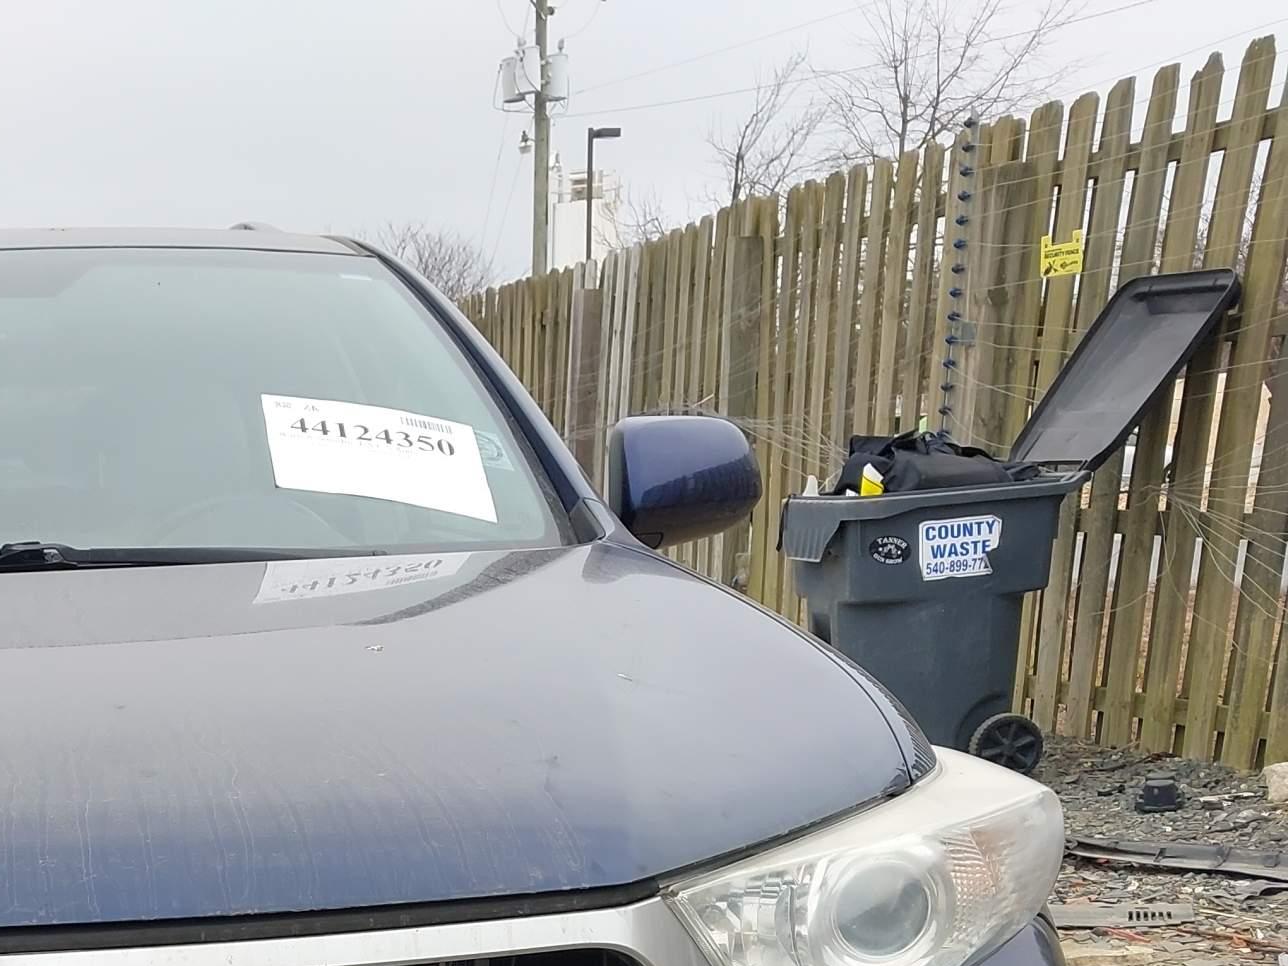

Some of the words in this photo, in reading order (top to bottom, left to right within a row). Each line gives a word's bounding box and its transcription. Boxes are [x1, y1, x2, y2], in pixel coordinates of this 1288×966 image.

[290, 417, 455, 456] 44124350
[925, 520, 996, 541] COUNTY
[931, 539, 991, 559] WASTE
